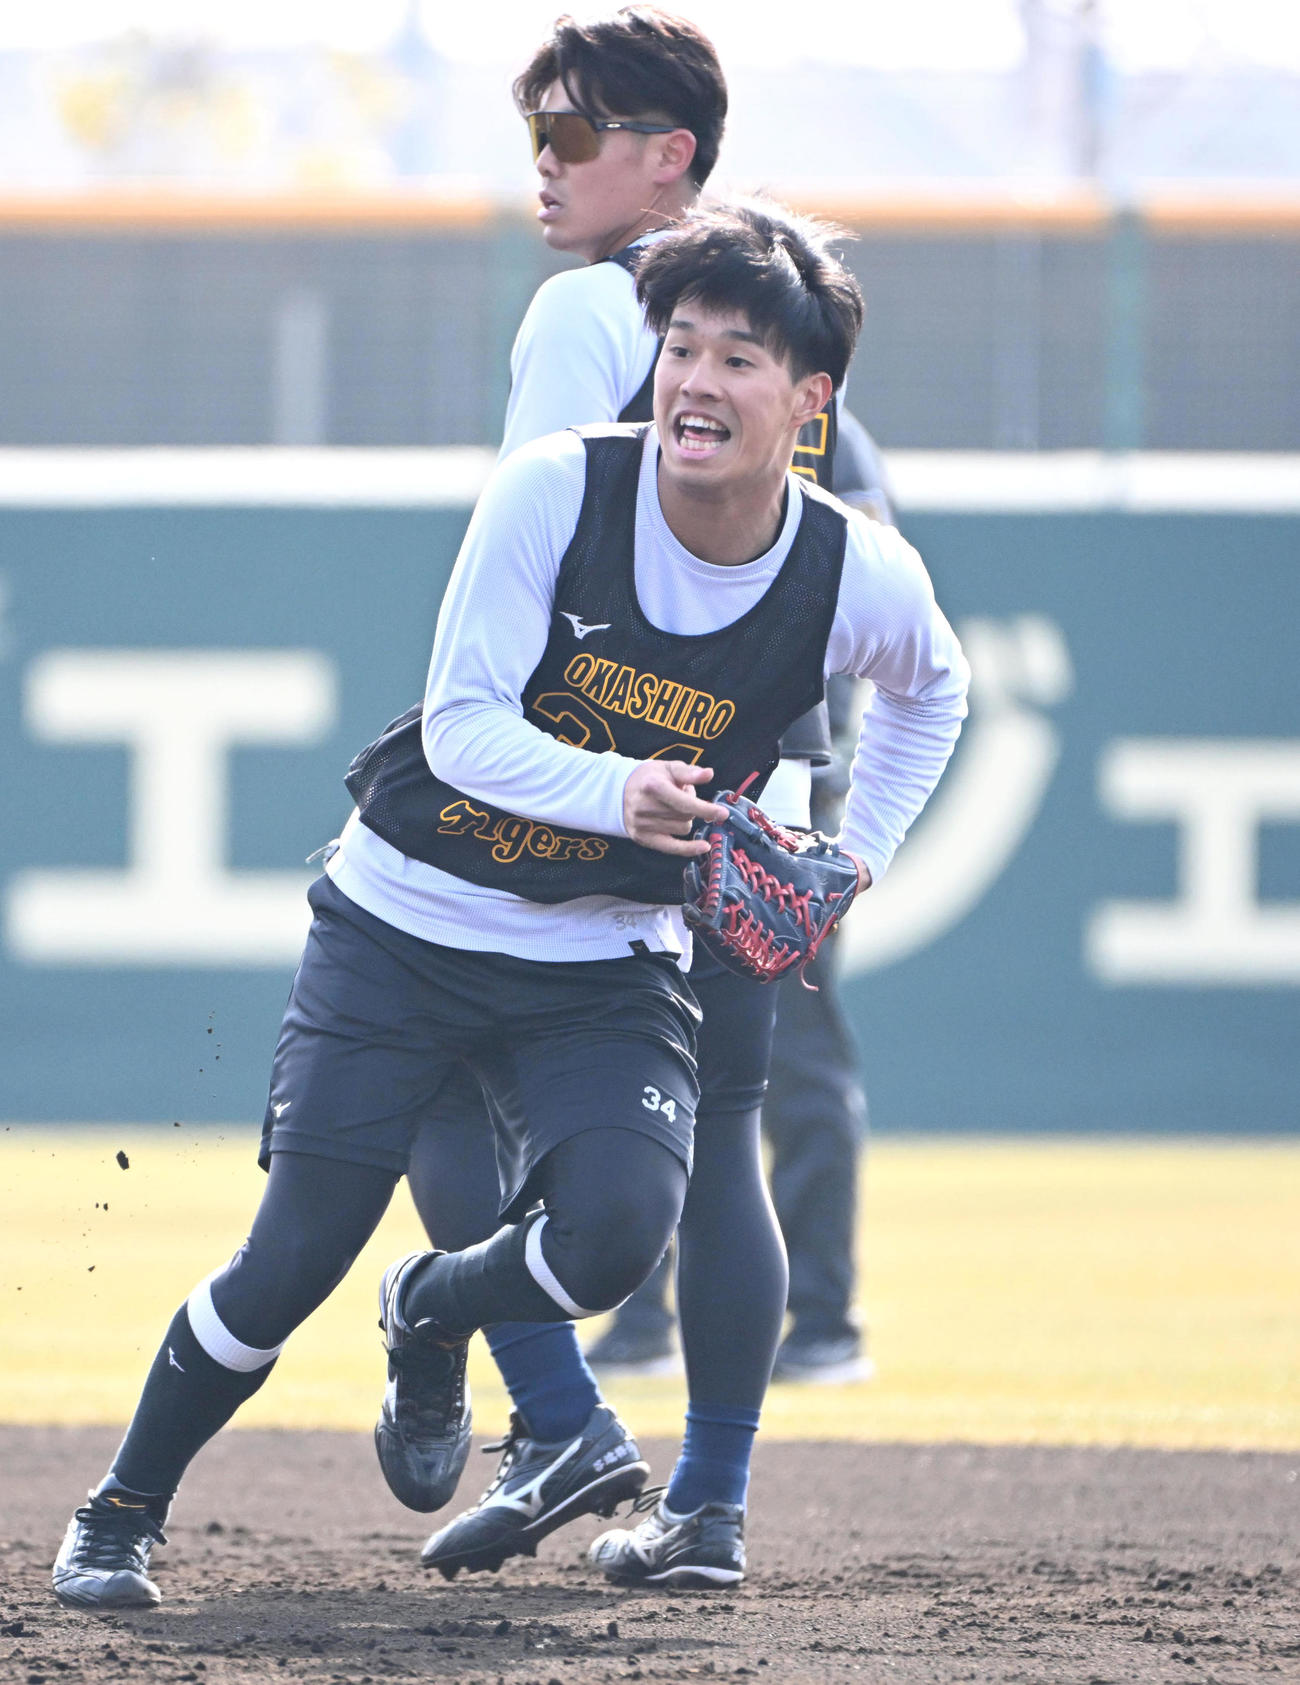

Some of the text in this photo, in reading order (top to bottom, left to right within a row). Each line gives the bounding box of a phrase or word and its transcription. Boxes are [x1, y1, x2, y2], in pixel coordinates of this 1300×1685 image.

[564, 653, 736, 740] OKASHIRO
[437, 800, 609, 863] Tigers
[614, 911, 637, 931] 34
[641, 1085, 676, 1123] 34
